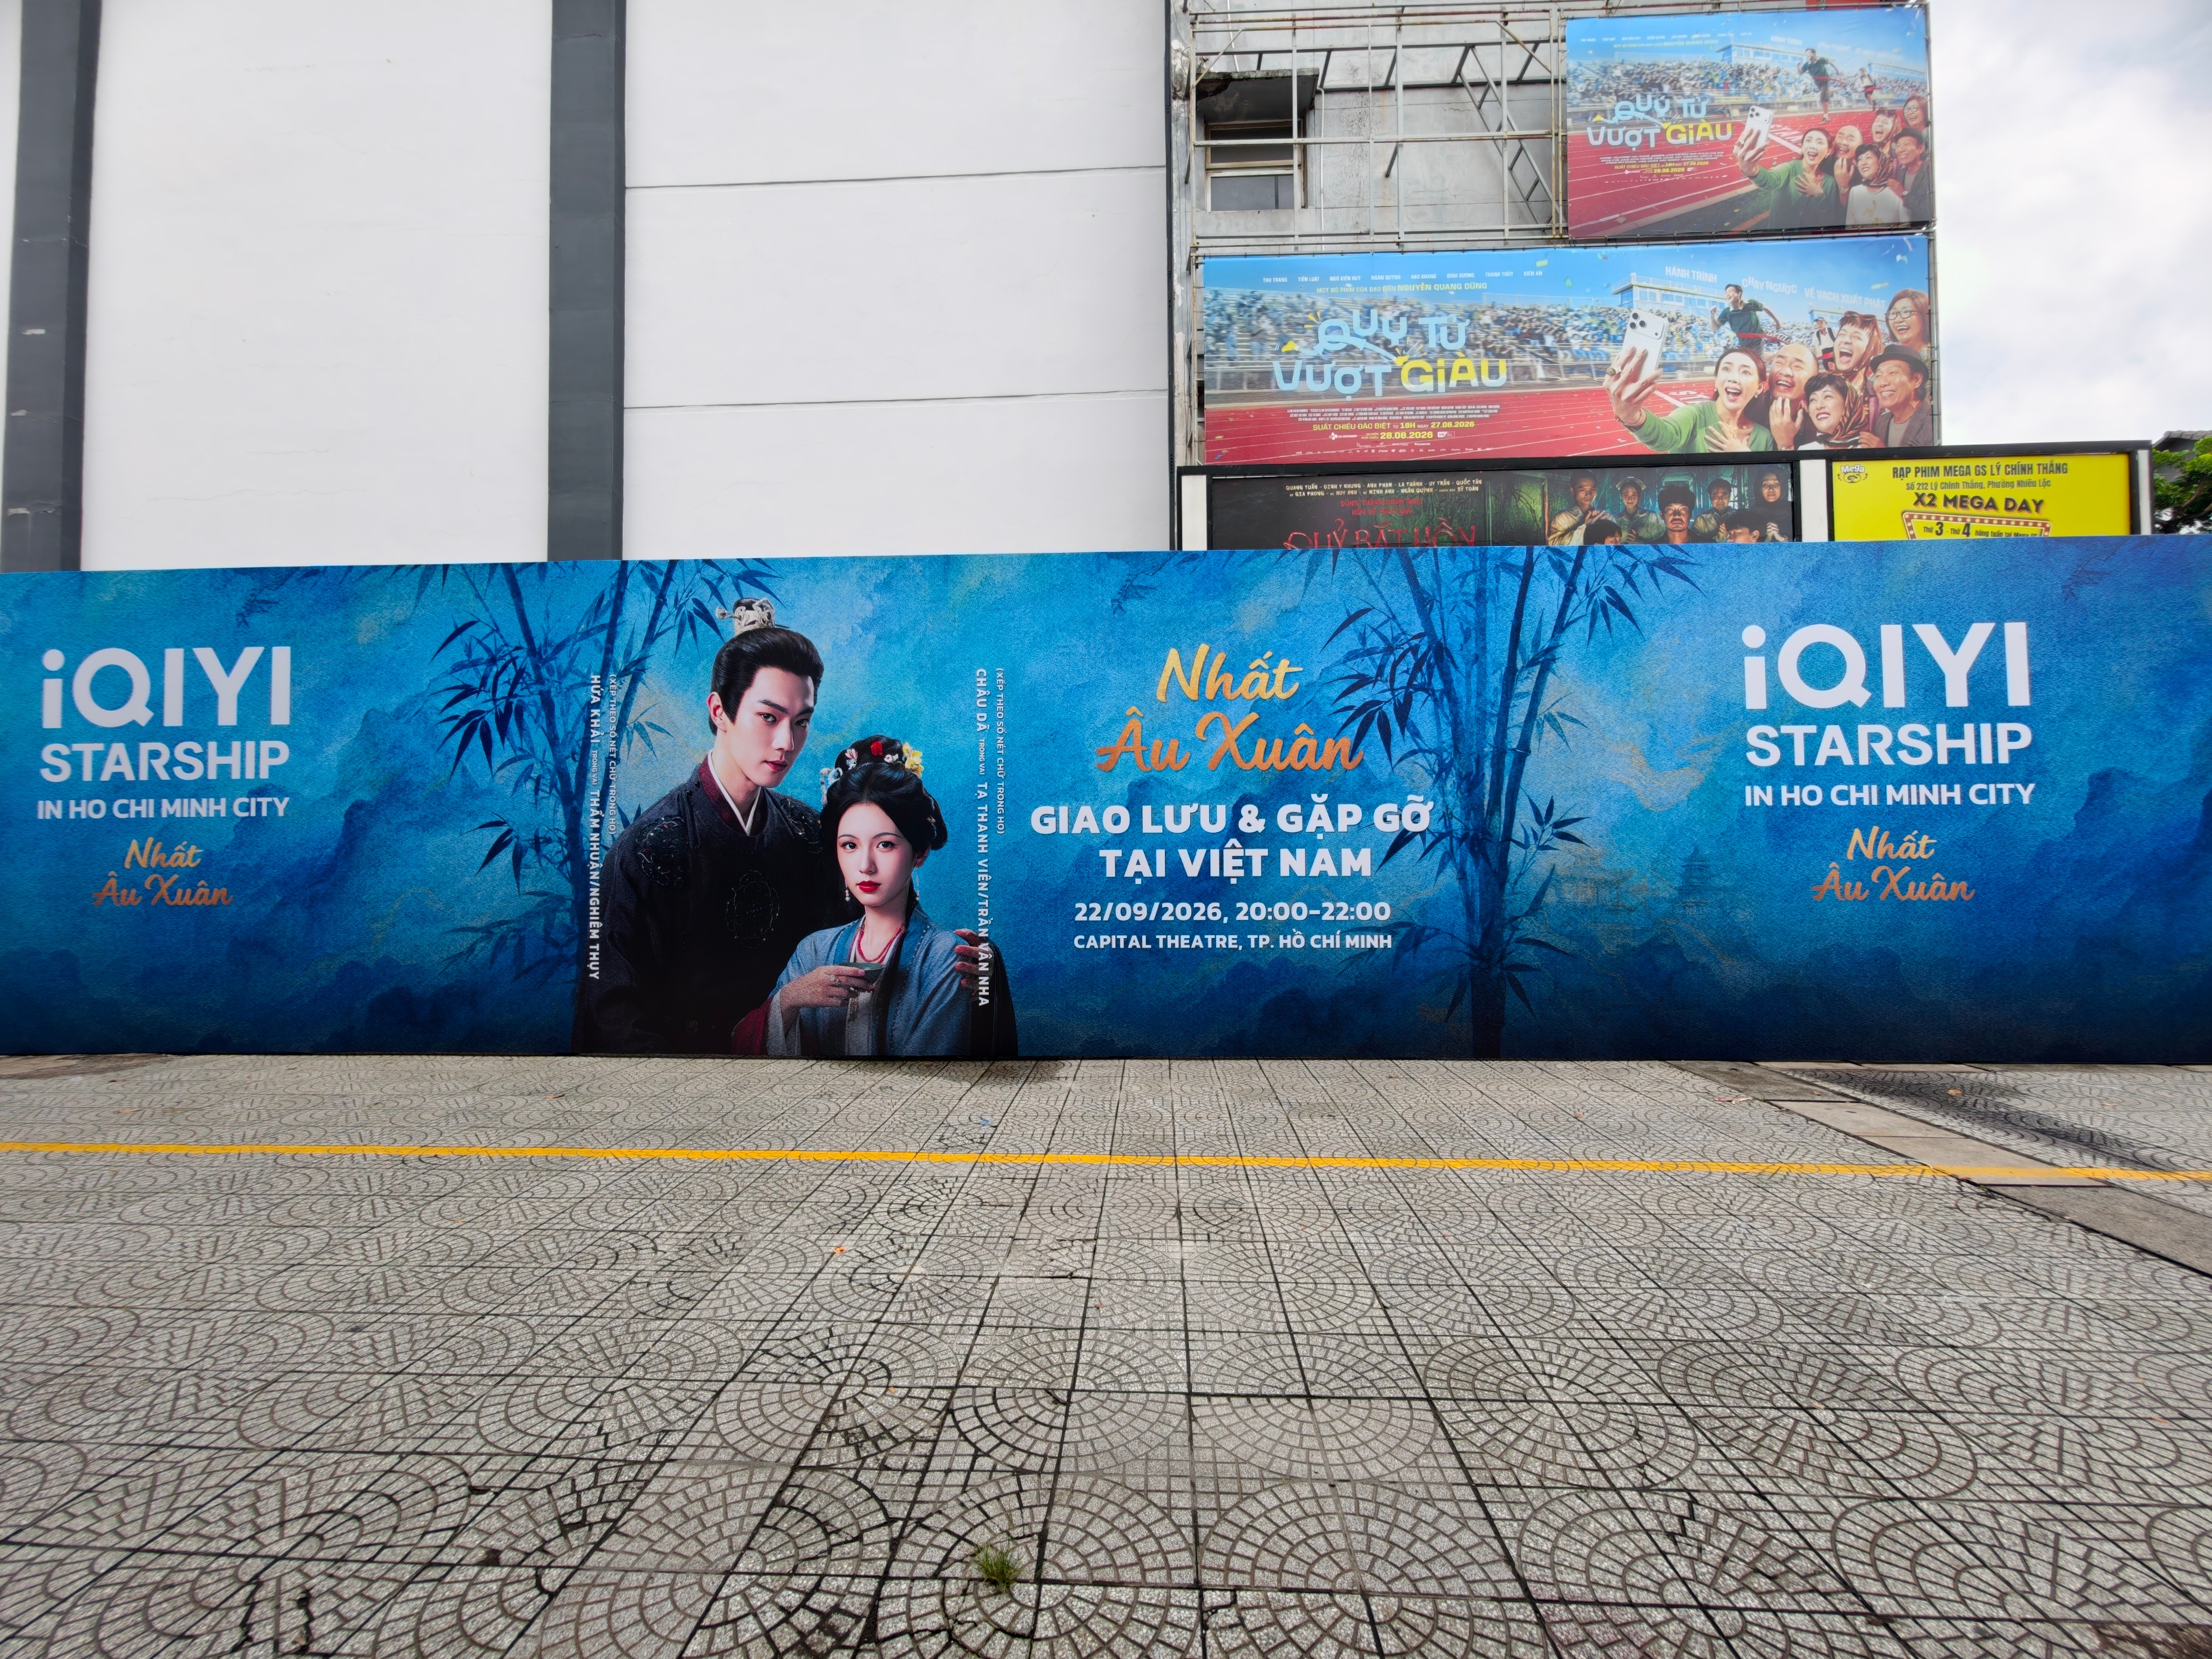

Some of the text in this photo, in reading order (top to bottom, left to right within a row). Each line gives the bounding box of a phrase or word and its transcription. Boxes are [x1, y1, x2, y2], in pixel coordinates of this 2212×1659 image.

[1678, 96, 1709, 119] TỬ
[1587, 126, 1661, 151] VƯỢT
[1317, 308, 1470, 353] QUÝ TỬ
[1272, 360, 1392, 401] VƯỢT
[1333, 422, 1356, 430] CHIẾU
[1374, 422, 1391, 430] BIỆT
[1840, 464, 1865, 474] Mega
[1892, 459, 2068, 481] RẠP PHIM MEGA GS LÝ CHÍNH THẮNG
[1906, 478, 2051, 491] Số 212 Lý Chính Thắng, Phường Nhiêu Lộc
[1913, 492, 2045, 515] X2 MEGA DAY
[1935, 521, 1944, 536] 3
[1962, 523, 1971, 537] 4
[1156, 643, 1303, 703] Nhất
[1742, 622, 2031, 710] iQIYI
[42, 646, 291, 729] iQIYI
[590, 675, 604, 704] HỨA
[609, 673, 619, 696] (XẾP
[976, 669, 990, 707] CHÂU
[996, 667, 1007, 691] (XẾP
[590, 709, 604, 743] KHẢI
[609, 725, 619, 738] SỐ
[976, 713, 990, 732] DÃ
[996, 721, 1007, 734] SỐ
[609, 740, 619, 758] NÉT
[997, 737, 1007, 755] NÉT
[1096, 706, 1364, 772] Âu Xuân
[1746, 723, 2032, 767] STARSHIP
[40, 740, 289, 783] STARSHIP
[609, 761, 618, 782] CHỮ
[997, 758, 1006, 779] CHỮ
[975, 782, 988, 799] TẠ
[1745, 783, 2036, 806] IN HO CHI MINH CITY
[37, 797, 289, 820] IN HO CHI MINH CITY
[590, 790, 604, 828] THẨM
[1030, 793, 1434, 840] GIAO LƯU & GẶP GỠ
[608, 818, 616, 835] HỌ)
[977, 805, 989, 853] THANH
[996, 817, 1004, 834] HỌ)
[124, 837, 204, 869] Nhất
[1846, 825, 1937, 860] Nhất
[1099, 838, 1371, 885] TẠI VIỆT NAM
[91, 871, 234, 907] Âu Xuân
[1811, 861, 1975, 901] Âu Xuân
[1075, 902, 1229, 924] 22/09/2026,
[1074, 928, 1392, 950] CAPITAL THEATRE, TP. HỒ CHÍ MINH
[586, 943, 599, 980] THỤY
[978, 942, 992, 971] VÂN
[978, 976, 989, 1006] NHA
